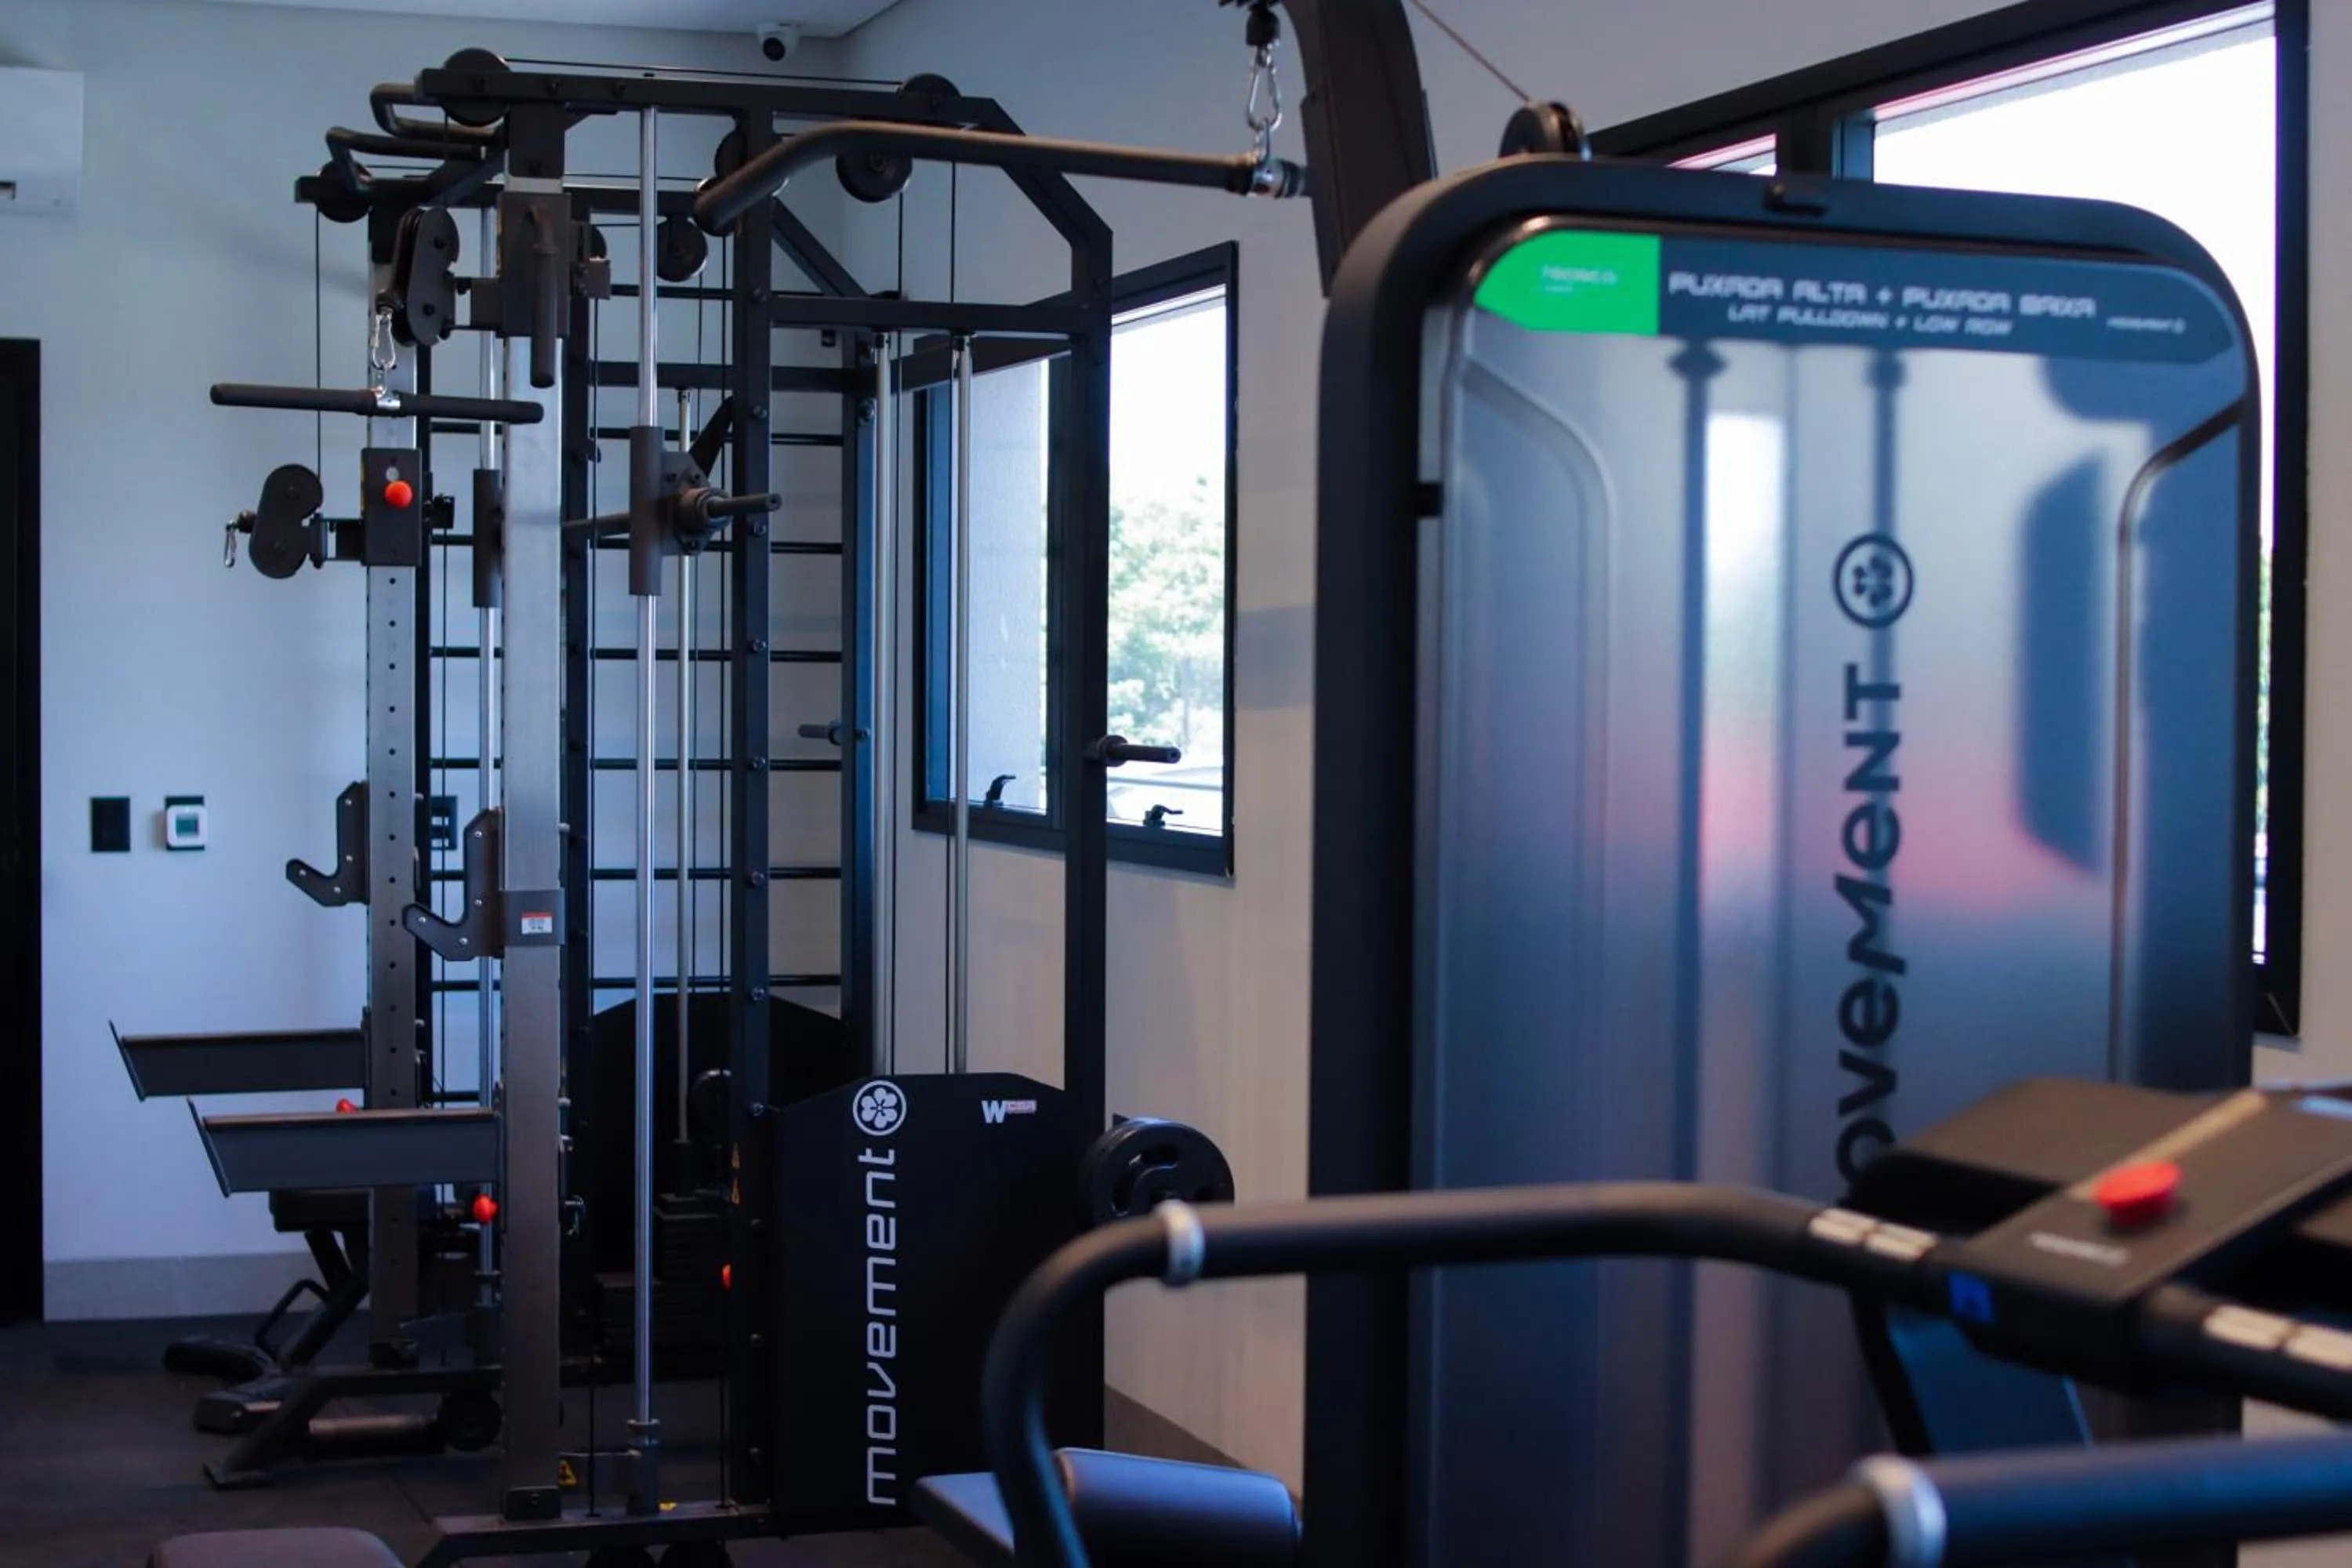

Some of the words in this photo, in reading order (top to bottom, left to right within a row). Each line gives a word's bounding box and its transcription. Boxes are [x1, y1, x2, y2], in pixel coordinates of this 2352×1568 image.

[1793, 279, 1867, 306] ALTA
[1876, 285, 1893, 307] +
[1727, 302, 1772, 324] LAT
[1913, 314, 1958, 334] LOW
[1964, 317, 2013, 336] ROW
[858, 1147, 897, 1505] movement
